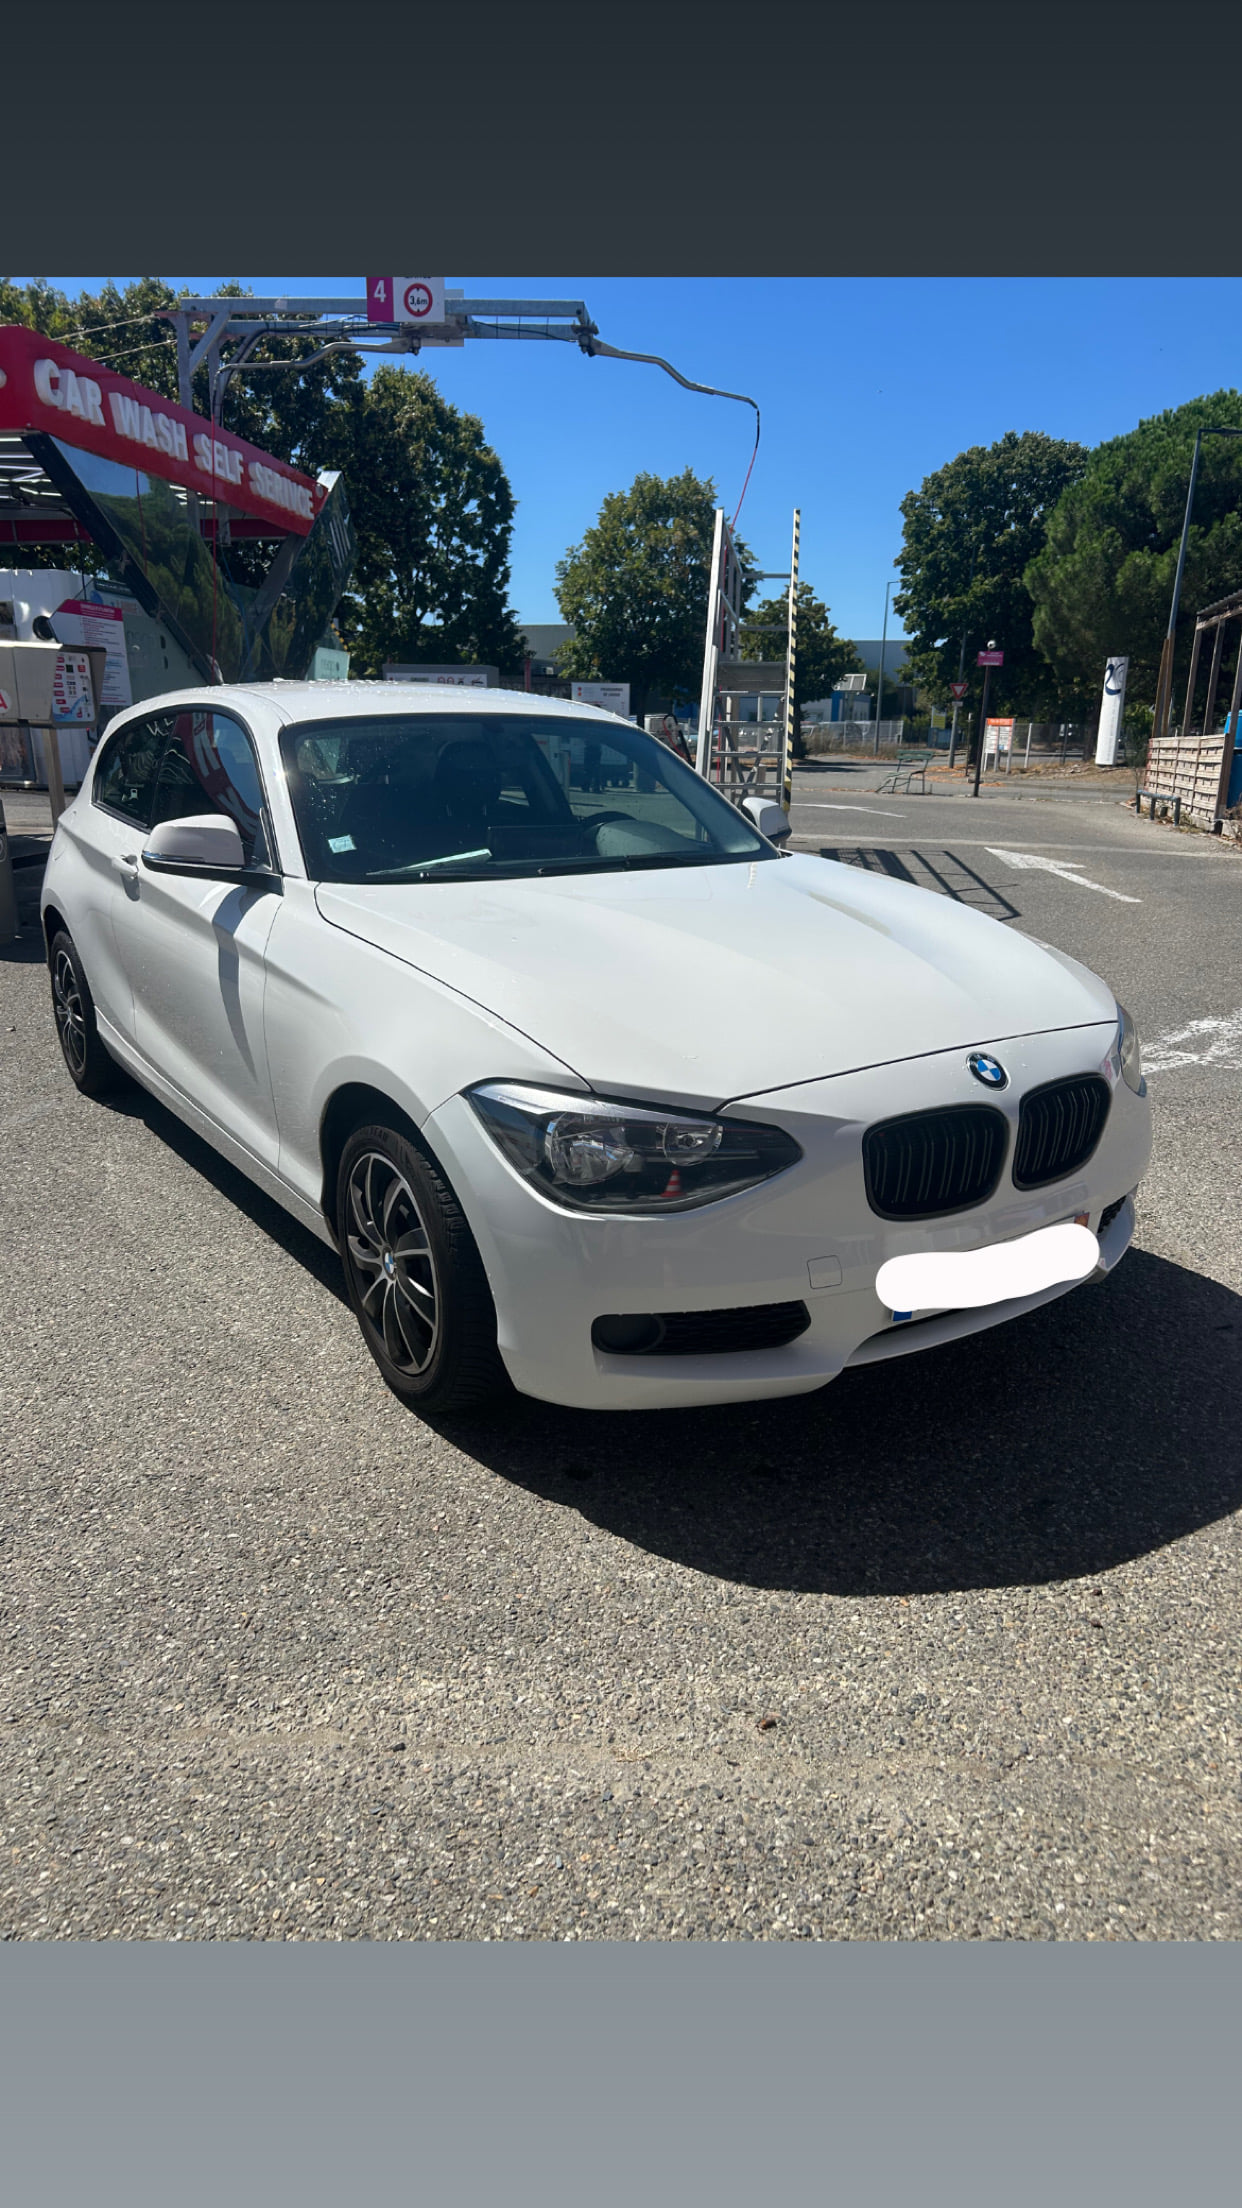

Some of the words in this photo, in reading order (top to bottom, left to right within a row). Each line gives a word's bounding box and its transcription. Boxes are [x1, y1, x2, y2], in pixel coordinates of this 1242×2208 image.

[374, 280, 386, 302] 4
[33, 358, 106, 427] CAR
[109, 391, 189, 462] WASH
[193, 433, 244, 485] SELF
